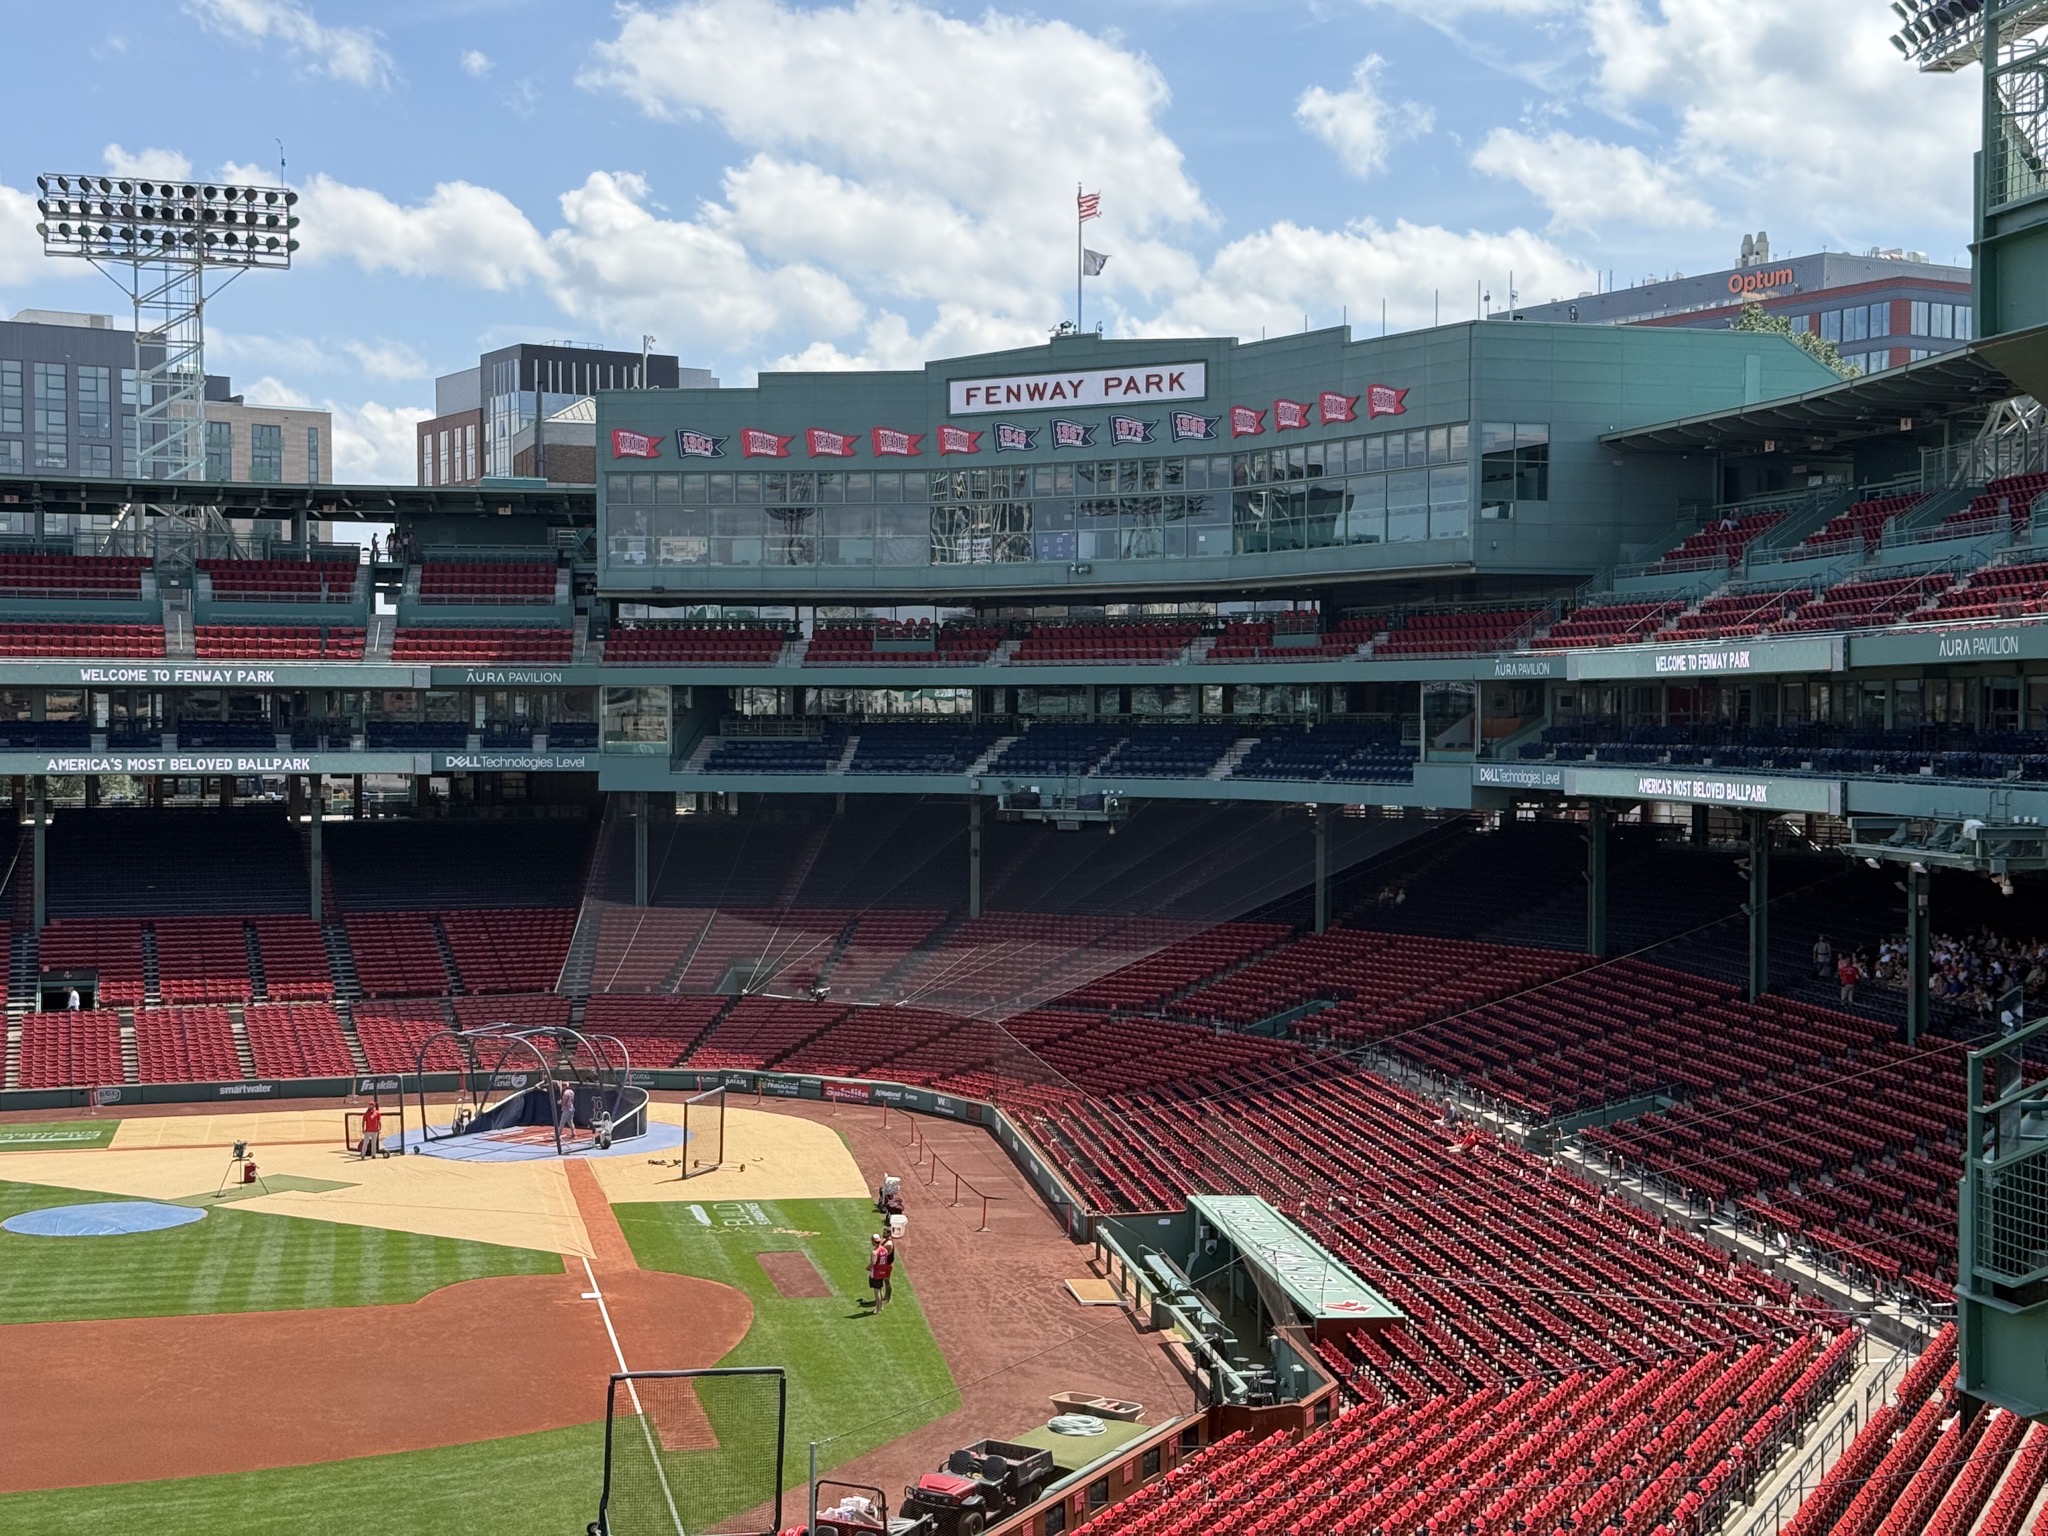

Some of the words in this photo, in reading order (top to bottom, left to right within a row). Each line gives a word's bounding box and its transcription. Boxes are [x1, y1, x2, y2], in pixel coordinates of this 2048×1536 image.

[1728, 266, 1793, 294] Optum
[966, 379, 1084, 406] FENWAY
[1104, 372, 1186, 396] PARK
[999, 429, 1026, 444] 1946
[1057, 426, 1084, 441] 1967
[1116, 422, 1144, 437] 1975
[750, 435, 777, 451] 1912
[815, 435, 843, 451] 1915
[1973, 636, 2018, 654] PAVILION
[1656, 654, 1686, 671] WELCOME
[1688, 654, 1696, 670] TO
[1698, 652, 1728, 670] FENWAY
[1730, 650, 1750, 668] PARK
[80, 669, 147, 682] WELCOME
[152, 669, 170, 682] TO
[175, 670, 232, 682] FENWAY
[237, 670, 274, 683] PARK
[1518, 662, 1550, 675] PAVILION
[508, 672, 562, 683] PAVILION
[47, 757, 123, 771] AMERICA'S
[128, 758, 165, 771] MOST
[170, 758, 233, 771] BELOVED
[238, 758, 310, 771] BALLPARK
[556, 756, 585, 768] Level
[1542, 772, 1560, 785] Level
[1638, 778, 1672, 795] AMERICA'S
[1673, 779, 1691, 796] MOST
[1693, 780, 1725, 799] BELOVED
[1727, 782, 1767, 802] BALLPARK
[220, 1084, 272, 1094] smartwater
